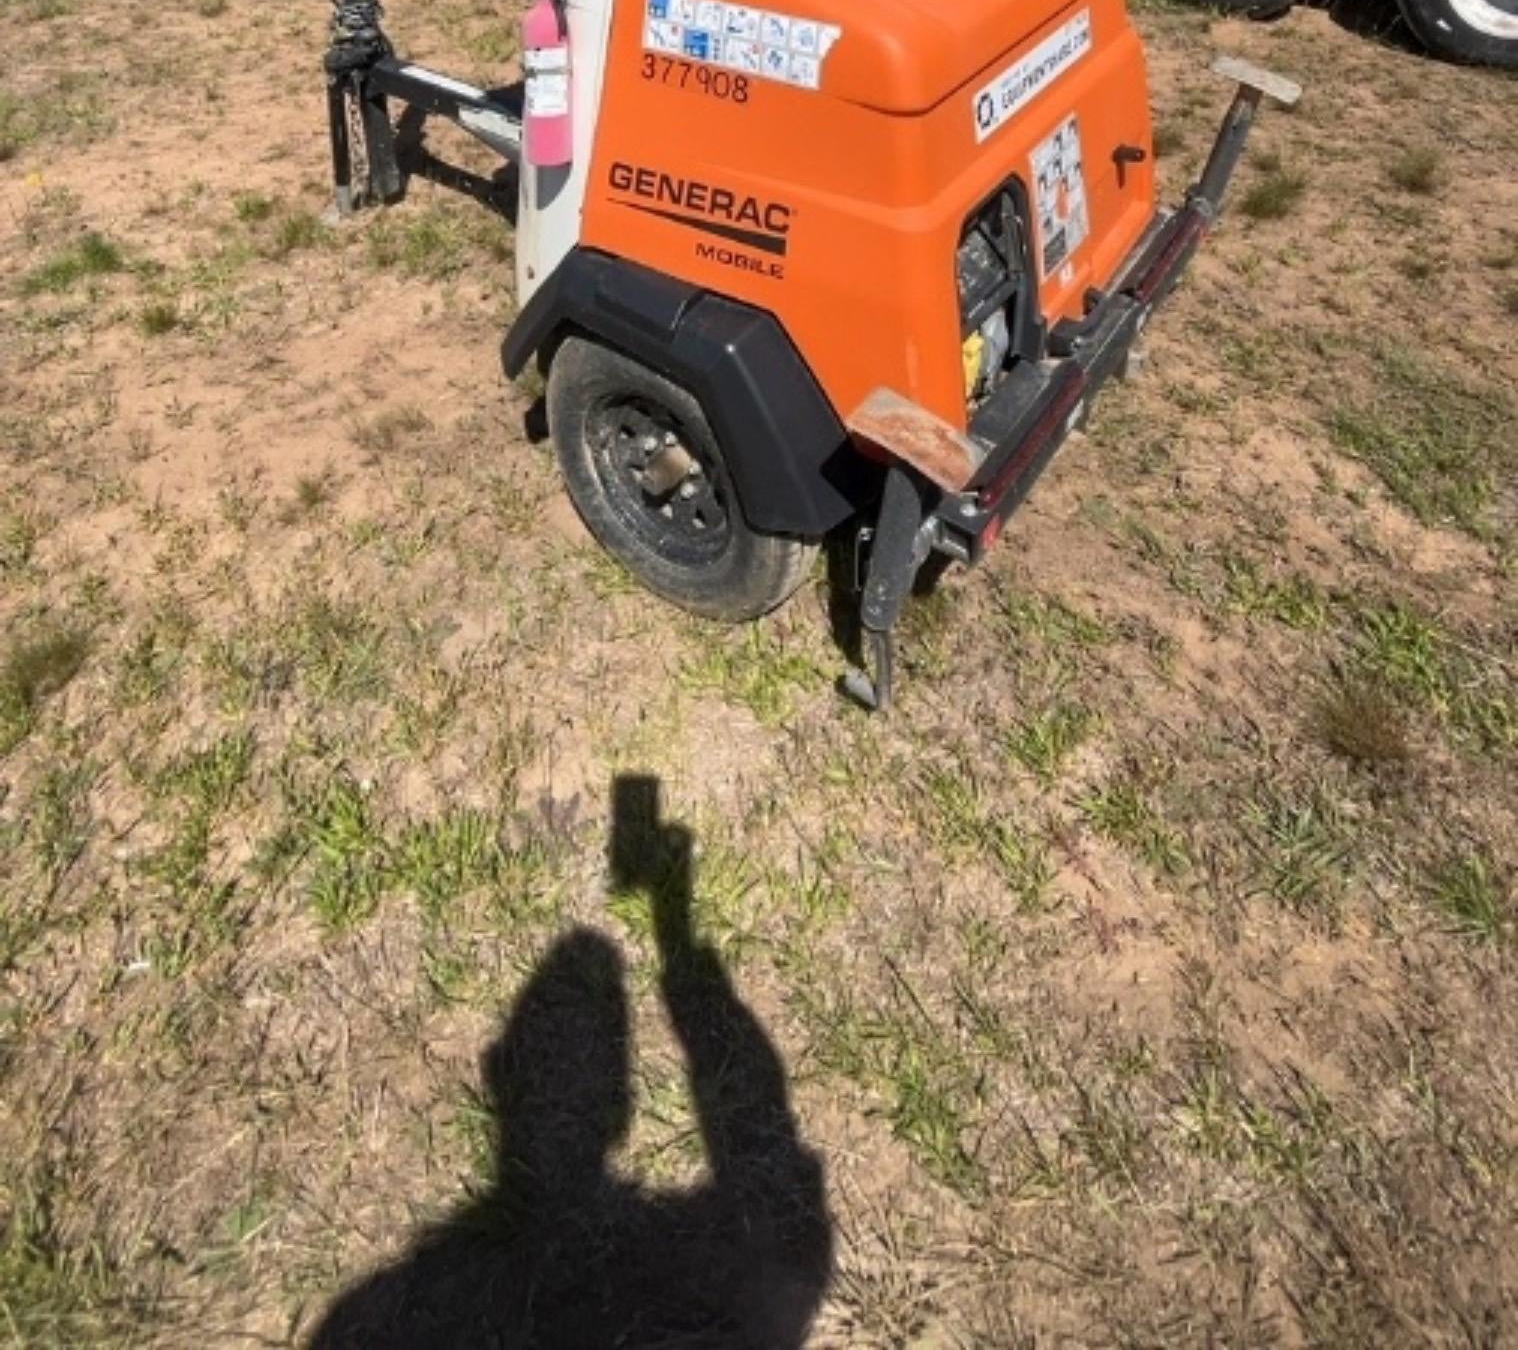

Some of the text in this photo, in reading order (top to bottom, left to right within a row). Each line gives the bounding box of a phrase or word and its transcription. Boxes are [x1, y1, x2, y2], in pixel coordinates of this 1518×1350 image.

[641, 53, 749, 103] 377908
[608, 161, 791, 234] GENERAC
[695, 242, 784, 280] MOBILE
